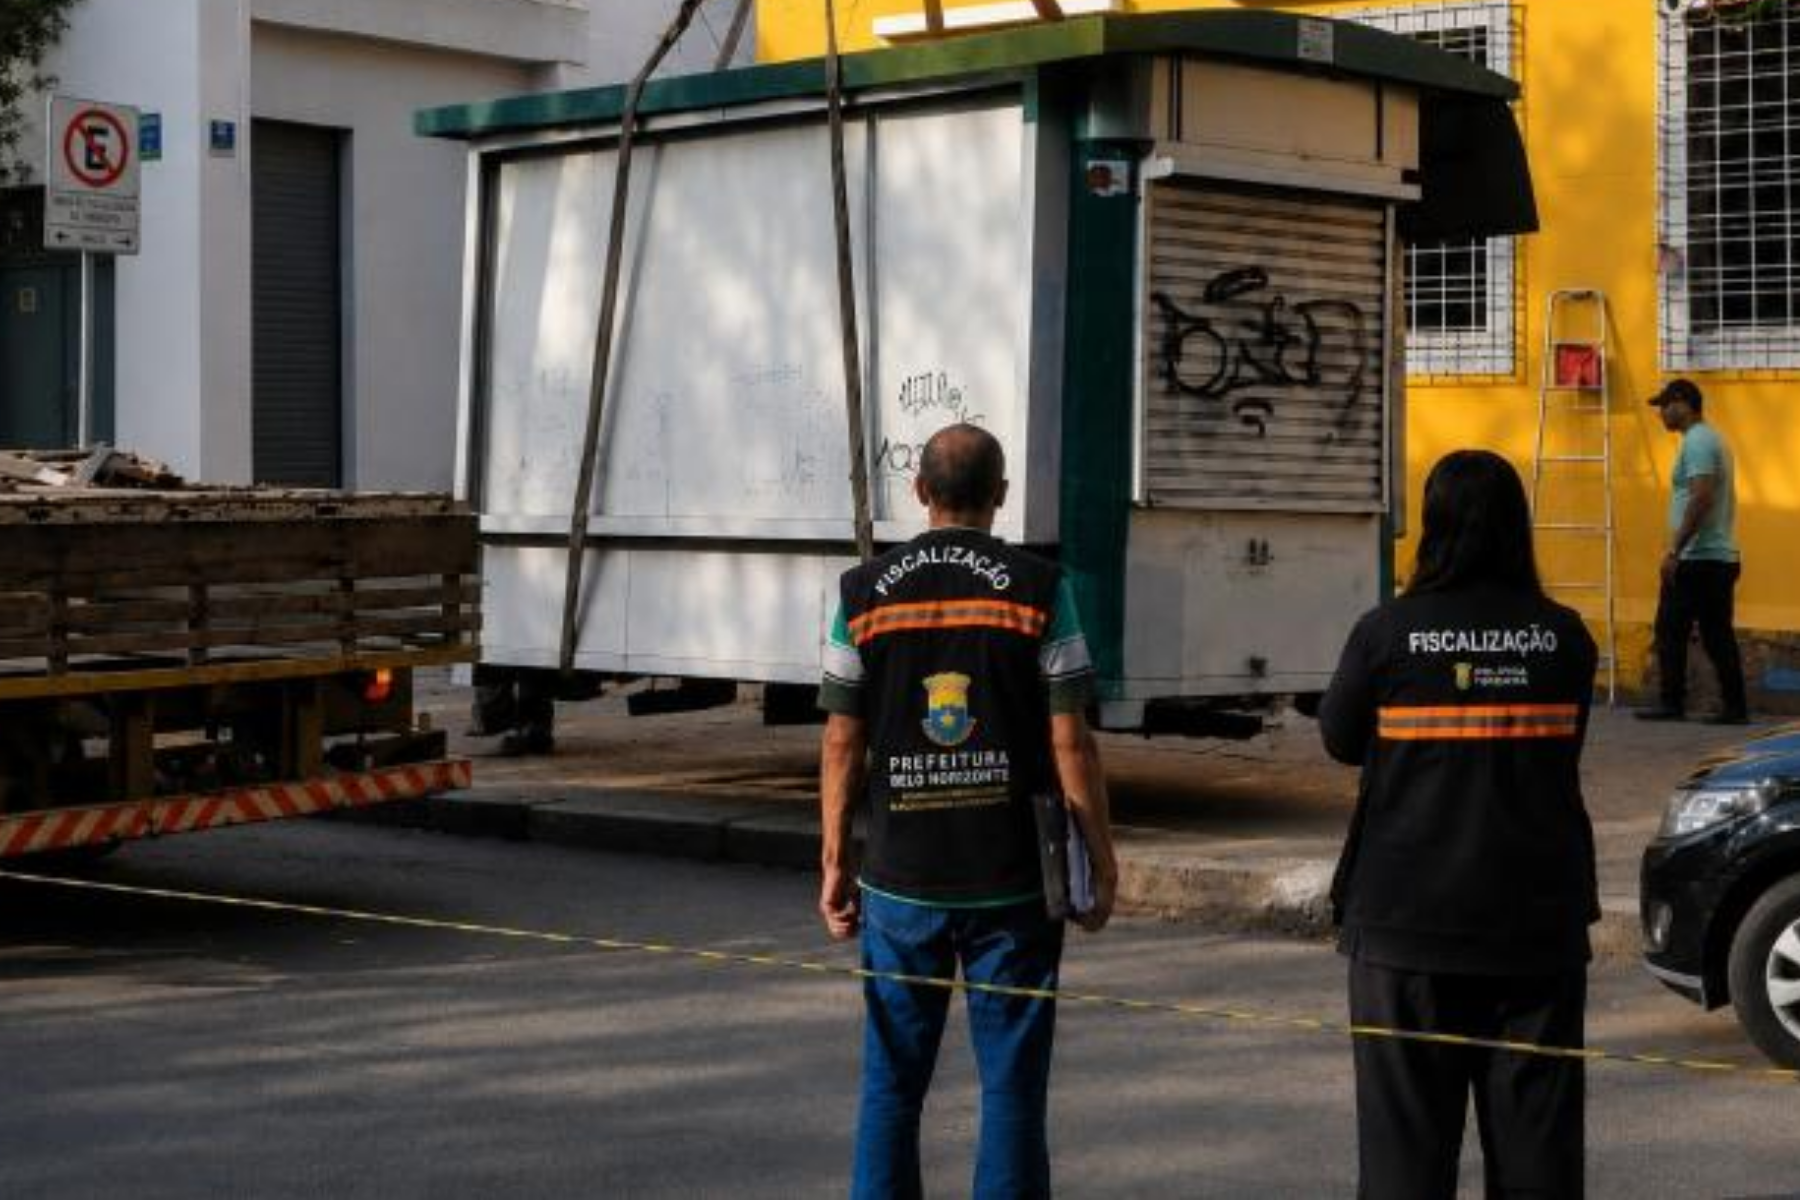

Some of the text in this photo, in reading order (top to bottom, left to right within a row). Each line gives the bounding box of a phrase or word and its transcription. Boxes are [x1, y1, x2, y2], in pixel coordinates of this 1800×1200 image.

[874, 545, 1011, 597] FISCALIZAÇÃO
[1408, 623, 1558, 657] FISCALIZAÇÃO
[889, 750, 1010, 773] PREFEITURA
[889, 773, 924, 788] BELO
